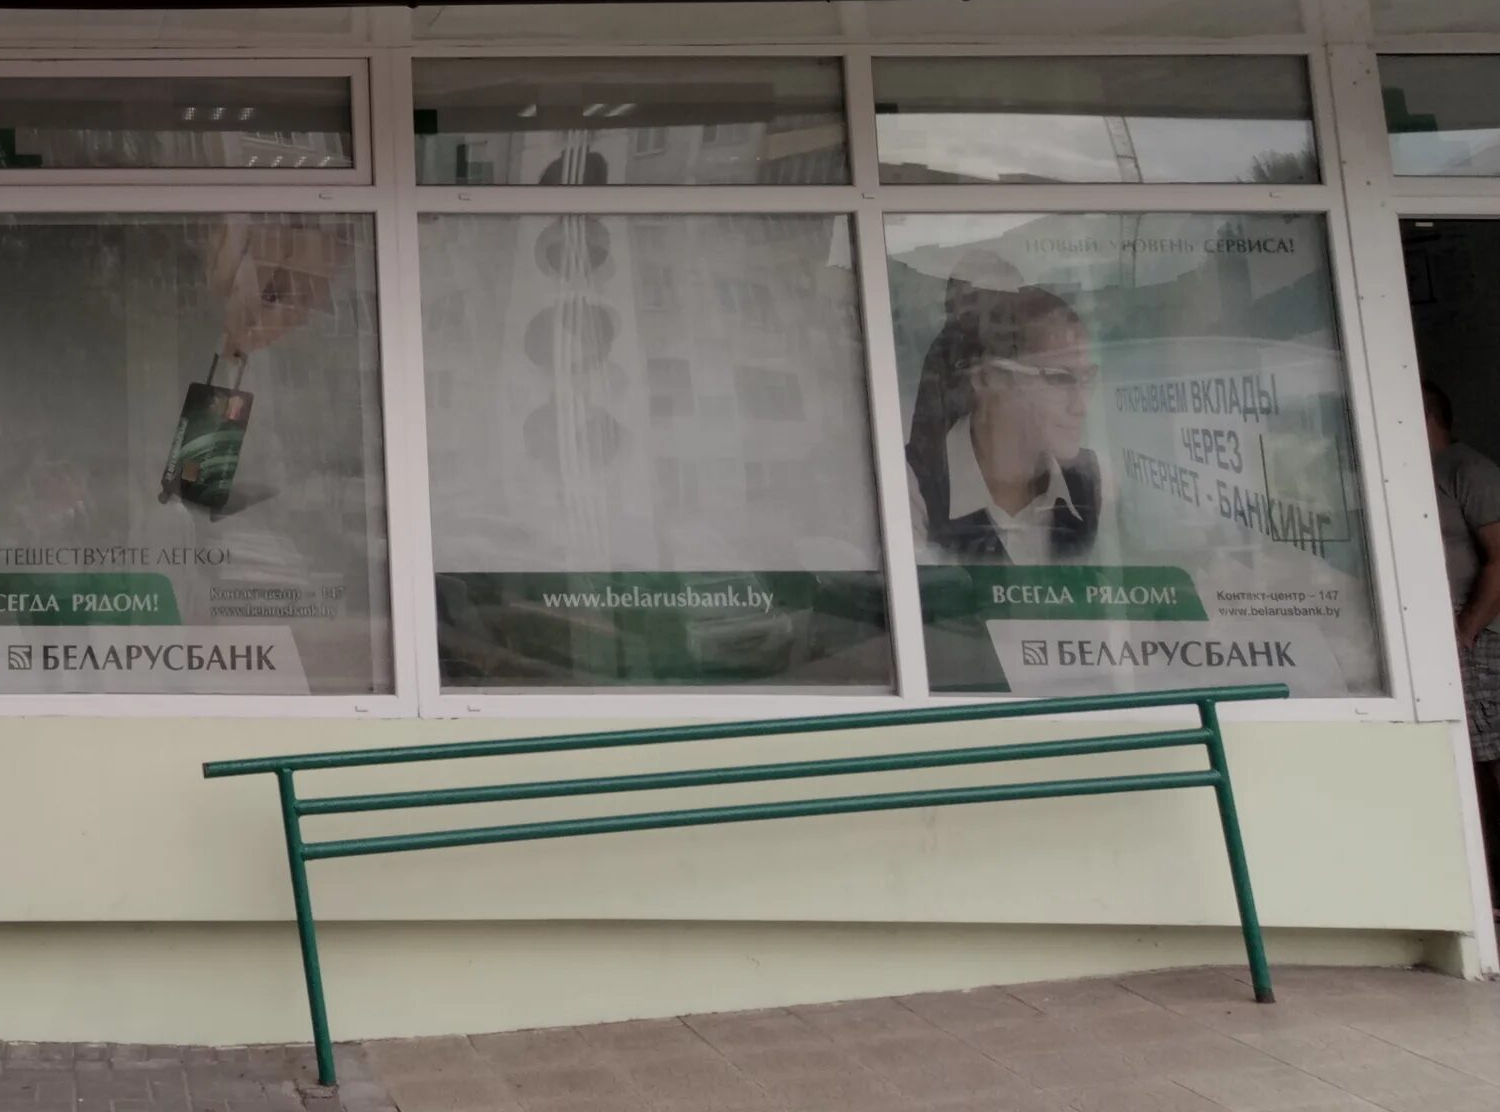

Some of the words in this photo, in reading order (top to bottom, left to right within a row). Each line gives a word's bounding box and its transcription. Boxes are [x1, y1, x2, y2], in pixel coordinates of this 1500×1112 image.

[1025, 237, 1099, 254] НОВЫЙ
[1203, 237, 1295, 254] СЕРВИСА!
[1115, 381, 1188, 414] ОТКРЫВАЕМ
[1190, 373, 1280, 423] ВКЛАДЫ
[1180, 427, 1243, 474] ЧЕРЕЗ
[1122, 448, 1200, 508] ИНТЕРНЕТ
[1216, 479, 1331, 559] БАНКИНГ
[156, 548, 231, 565] ЛЕГКО!
[72, 592, 159, 612] РЯДОМ!
[543, 585, 774, 614] www.belarusbank.by
[993, 585, 1074, 604] ВСЕГДА
[1086, 585, 1178, 605] РЯДОМ!
[1216, 590, 1306, 603] Контакт-центр
[1318, 590, 1339, 601] 147
[1217, 606, 1341, 618] www.belarusbank.by
[42, 644, 276, 671] БЕЛАРУСБАНК
[1058, 641, 1296, 668] БЕЛАРУСБАНК
